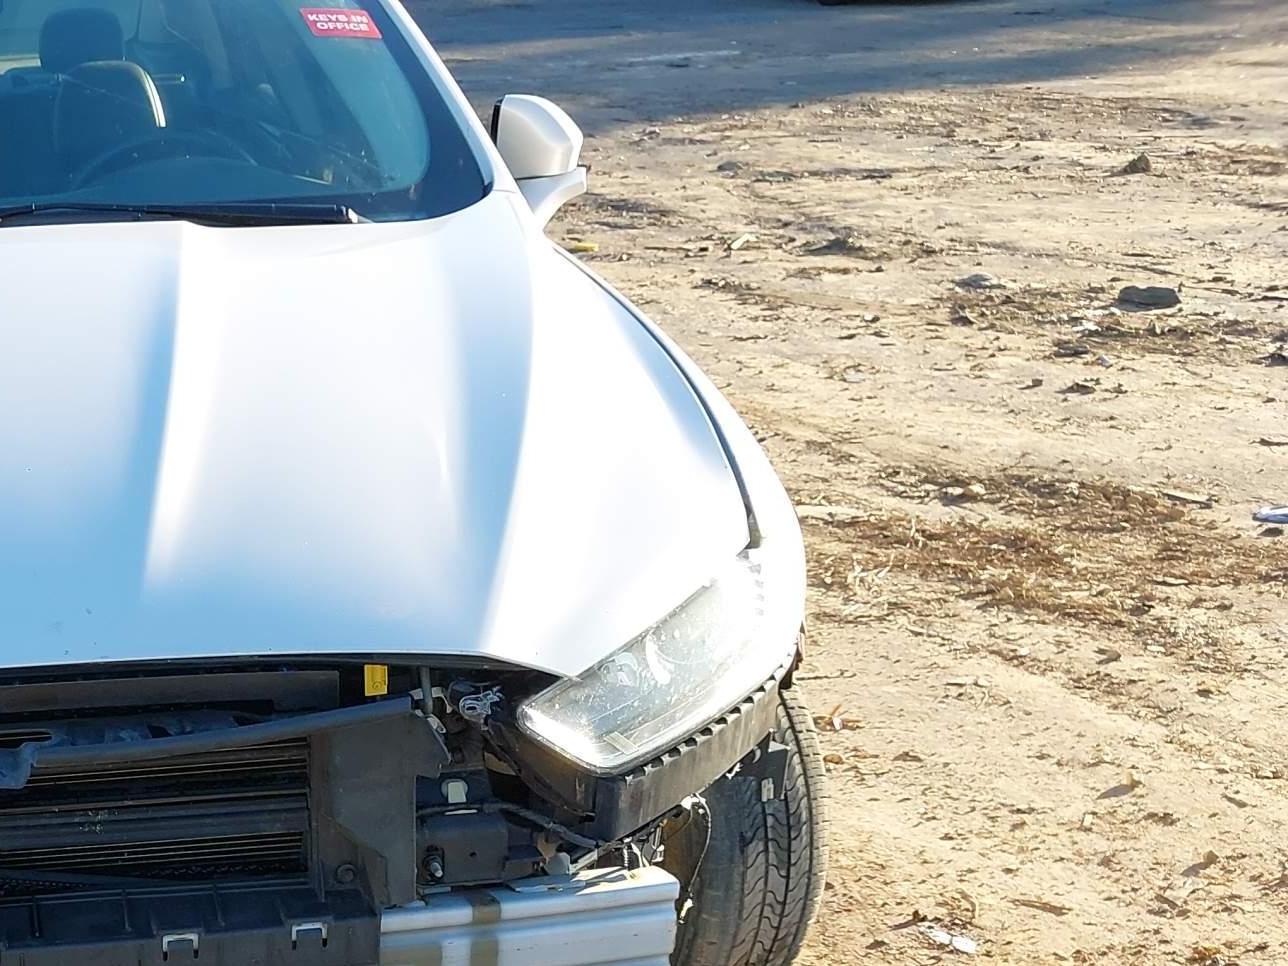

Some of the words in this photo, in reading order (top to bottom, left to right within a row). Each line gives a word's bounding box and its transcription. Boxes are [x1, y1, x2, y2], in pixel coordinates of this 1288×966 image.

[307, 13, 348, 22] KEYS
[350, 15, 369, 23] IN
[316, 22, 370, 32] OFFICE
